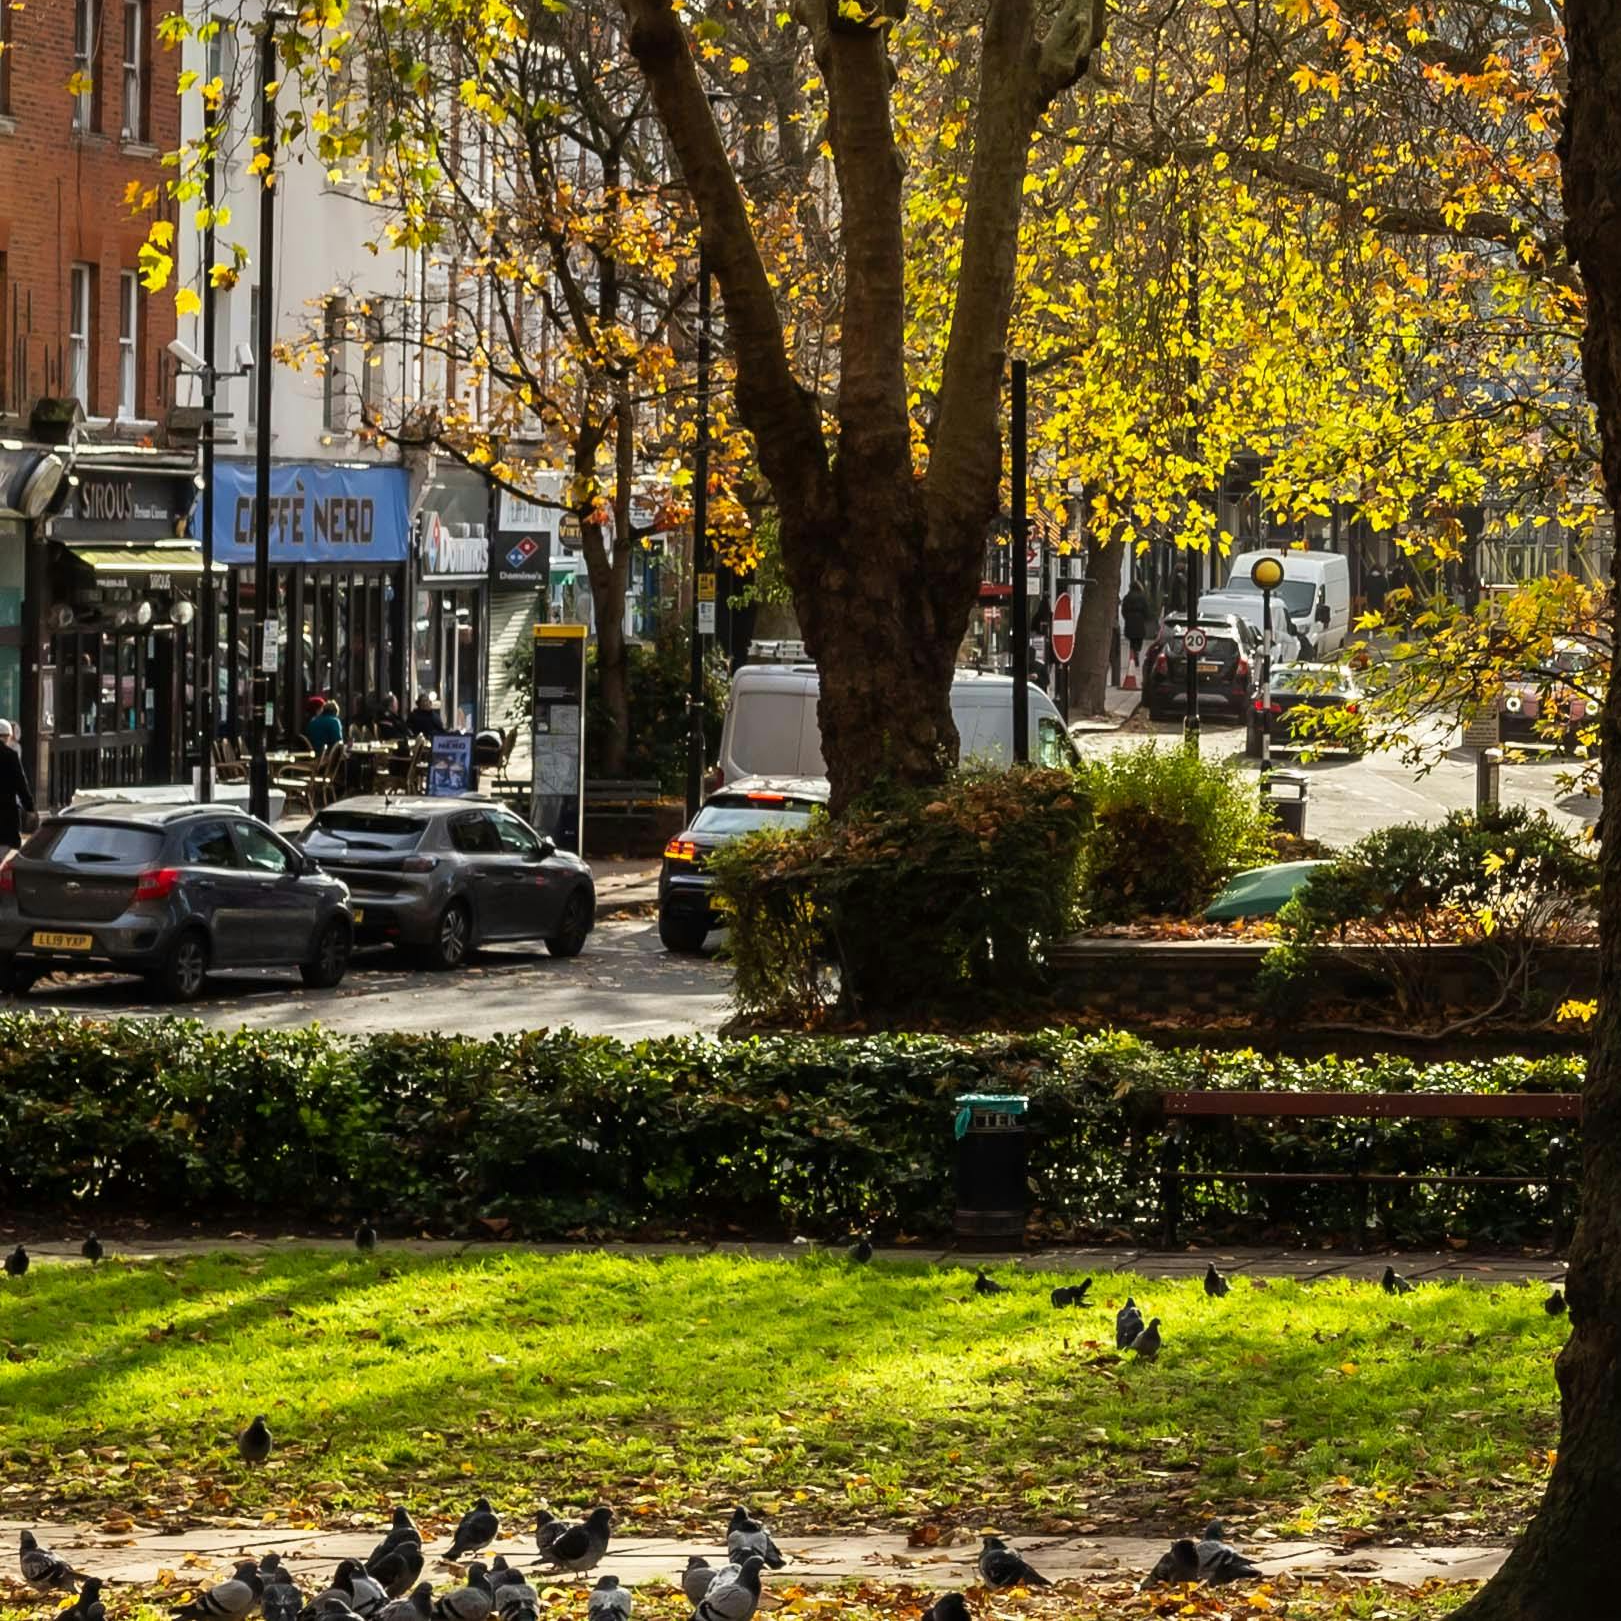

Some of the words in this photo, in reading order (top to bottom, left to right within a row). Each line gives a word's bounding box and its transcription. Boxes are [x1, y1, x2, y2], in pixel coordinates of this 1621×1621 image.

[82, 481, 133, 519] SIROUS
[313, 497, 375, 545] NERO
[499, 571, 543, 580] Domino's
[1187, 635, 1204, 646] 20
